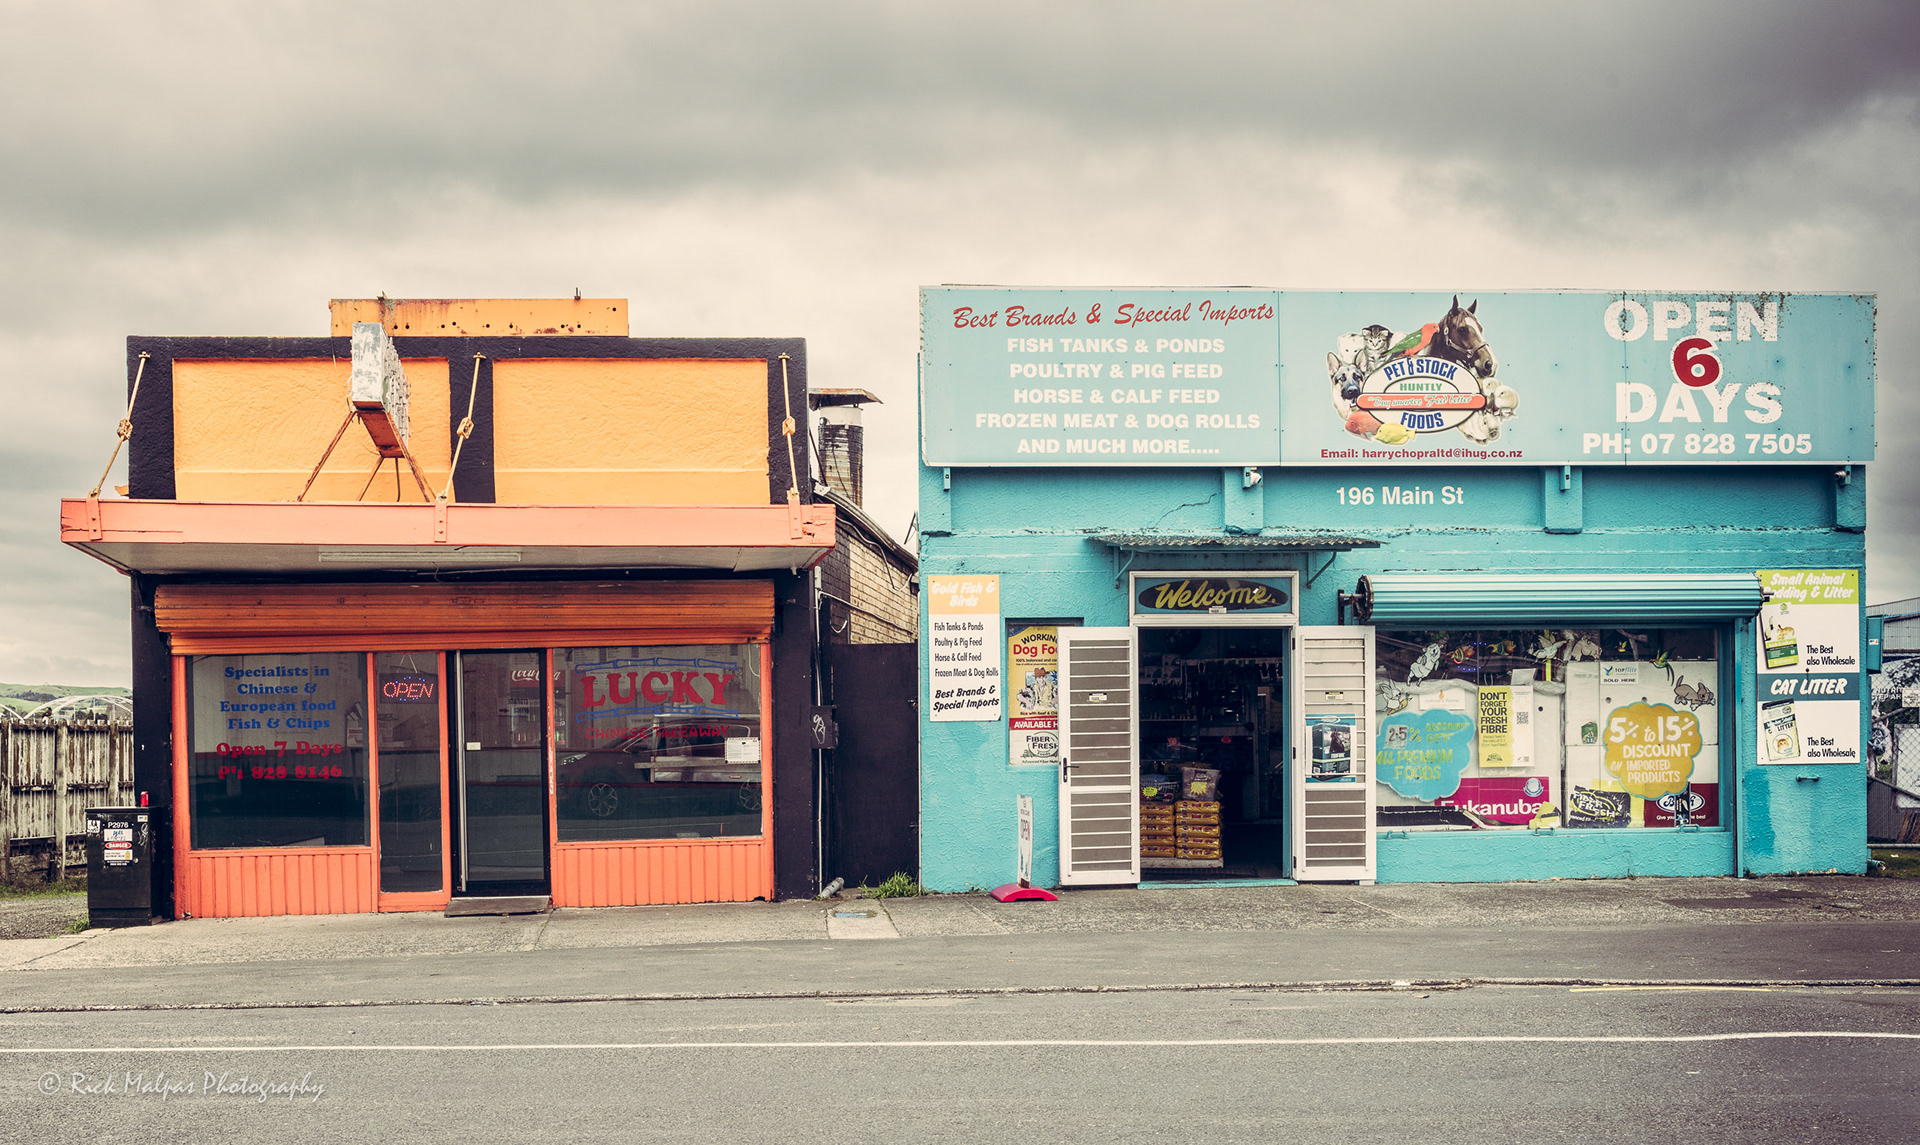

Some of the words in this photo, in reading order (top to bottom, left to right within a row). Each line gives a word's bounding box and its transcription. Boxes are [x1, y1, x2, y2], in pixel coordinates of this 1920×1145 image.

[953, 306, 998, 328] Best
[1005, 305, 1077, 328] Brands
[1086, 303, 1101, 324] &
[1114, 303, 1191, 328] Special
[1199, 300, 1274, 326] Imports
[1604, 300, 1778, 342] OPEN
[1007, 338, 1054, 353] FISH
[1060, 338, 1128, 353] TANKS
[1134, 338, 1150, 353] &
[1156, 338, 1225, 353] PONDS
[1672, 336, 1721, 388] 6
[1010, 364, 1101, 378] POULTRY
[1110, 364, 1124, 378] &
[1132, 364, 1165, 378] PIG
[1172, 364, 1223, 378] FEED
[1384, 360, 1407, 381] PET
[1406, 358, 1414, 376] &
[1416, 358, 1458, 380] STOCK
[1400, 382, 1442, 392] HUNTLY
[1014, 389, 1083, 404] HORSE
[1090, 389, 1104, 404] &
[1111, 389, 1162, 404] CALF
[1169, 389, 1220, 404] FEED
[1616, 382, 1782, 424] DAYS
[976, 414, 1056, 428] FROZEN
[1064, 414, 1118, 428] MEAT
[1124, 414, 1140, 428] &
[1146, 414, 1190, 428] DOG
[1196, 414, 1260, 429] ROLLS
[1400, 412, 1444, 430] FOODS
[1016, 439, 1060, 454] AND
[1066, 439, 1126, 454] MUCH
[1583, 434, 1632, 454] PH:
[1641, 434, 1675, 454] 07
[1684, 434, 1736, 454] 828
[1745, 434, 1812, 454] 7505
[1320, 448, 1358, 458] Email:
[1362, 448, 1522, 460] harrychopraltd@ihug.co.nz
[1336, 486, 1374, 505] 196
[1382, 486, 1434, 505] Main
[1441, 486, 1464, 505] St
[1770, 572, 1804, 585] Small
[1805, 572, 1846, 585] Animal
[932, 582, 958, 594] Gold
[960, 582, 982, 594] Fish
[986, 582, 996, 594] &
[1810, 586, 1820, 598] &
[1823, 586, 1854, 599] Litter
[949, 595, 979, 607] Birds
[934, 622, 945, 631] Fish
[946, 622, 961, 631] Tanks
[962, 622, 966, 630] &
[968, 622, 984, 631] Ponds
[934, 638, 953, 648] Poultry
[954, 638, 958, 646] &
[960, 638, 968, 648] Pig
[970, 637, 982, 646] Feed
[1806, 645, 1818, 654] The
[1821, 645, 1834, 654] Best
[935, 653, 950, 662] Horse
[951, 653, 956, 662] &
[957, 653, 968, 662] Calf
[969, 652, 982, 661] Feed
[1013, 644, 1038, 657] Dog
[1806, 656, 1820, 666] also
[1821, 656, 1855, 665] Wholesale
[224, 666, 308, 680] Specialists
[314, 666, 330, 676] in
[935, 668, 952, 677] Frozen
[953, 668, 967, 677] Meat
[968, 668, 972, 676] &
[974, 668, 985, 678] Dog
[986, 667, 999, 676] Rolls
[237, 683, 298, 694] Chinese
[304, 683, 317, 694] &
[383, 682, 433, 698] OPEN
[581, 672, 734, 708] LUCKY
[935, 689, 954, 699] Best
[956, 686, 986, 697] Brands
[989, 685, 996, 694] &
[1770, 678, 1798, 695] CAT
[1799, 678, 1848, 695] LITTER
[1480, 692, 1507, 700] DON'T
[220, 701, 296, 714] European
[302, 700, 336, 711] food
[933, 700, 964, 712] Special
[966, 698, 999, 709] Imports
[228, 719, 261, 729] Fish
[267, 718, 280, 729] &
[286, 718, 330, 730] Chips
[1426, 722, 1470, 731] DISCOUNT
[1481, 725, 1508, 733] FIBRE
[1609, 717, 1640, 744] 5%
[1644, 726, 1656, 742] to
[1658, 716, 1696, 743] 15%
[586, 727, 648, 739] CHINESE
[652, 725, 730, 738] TAKEAWAY
[1426, 733, 1454, 742] OFF
[1807, 737, 1819, 746] The
[1821, 737, 1834, 746] Best
[216, 743, 266, 758] Open
[274, 741, 287, 757] 7
[295, 741, 342, 757] Days
[1398, 749, 1453, 764] PREMIUM
[1623, 743, 1691, 759] DISCOUNT
[1807, 749, 1820, 758] also
[1821, 749, 1856, 758] Wholesale
[252, 766, 287, 779] 828
[295, 765, 342, 779] 8146
[1394, 765, 1441, 780] FOODS
[1626, 760, 1670, 771] IMPORTED
[1628, 771, 1680, 784] PRODUCTS
